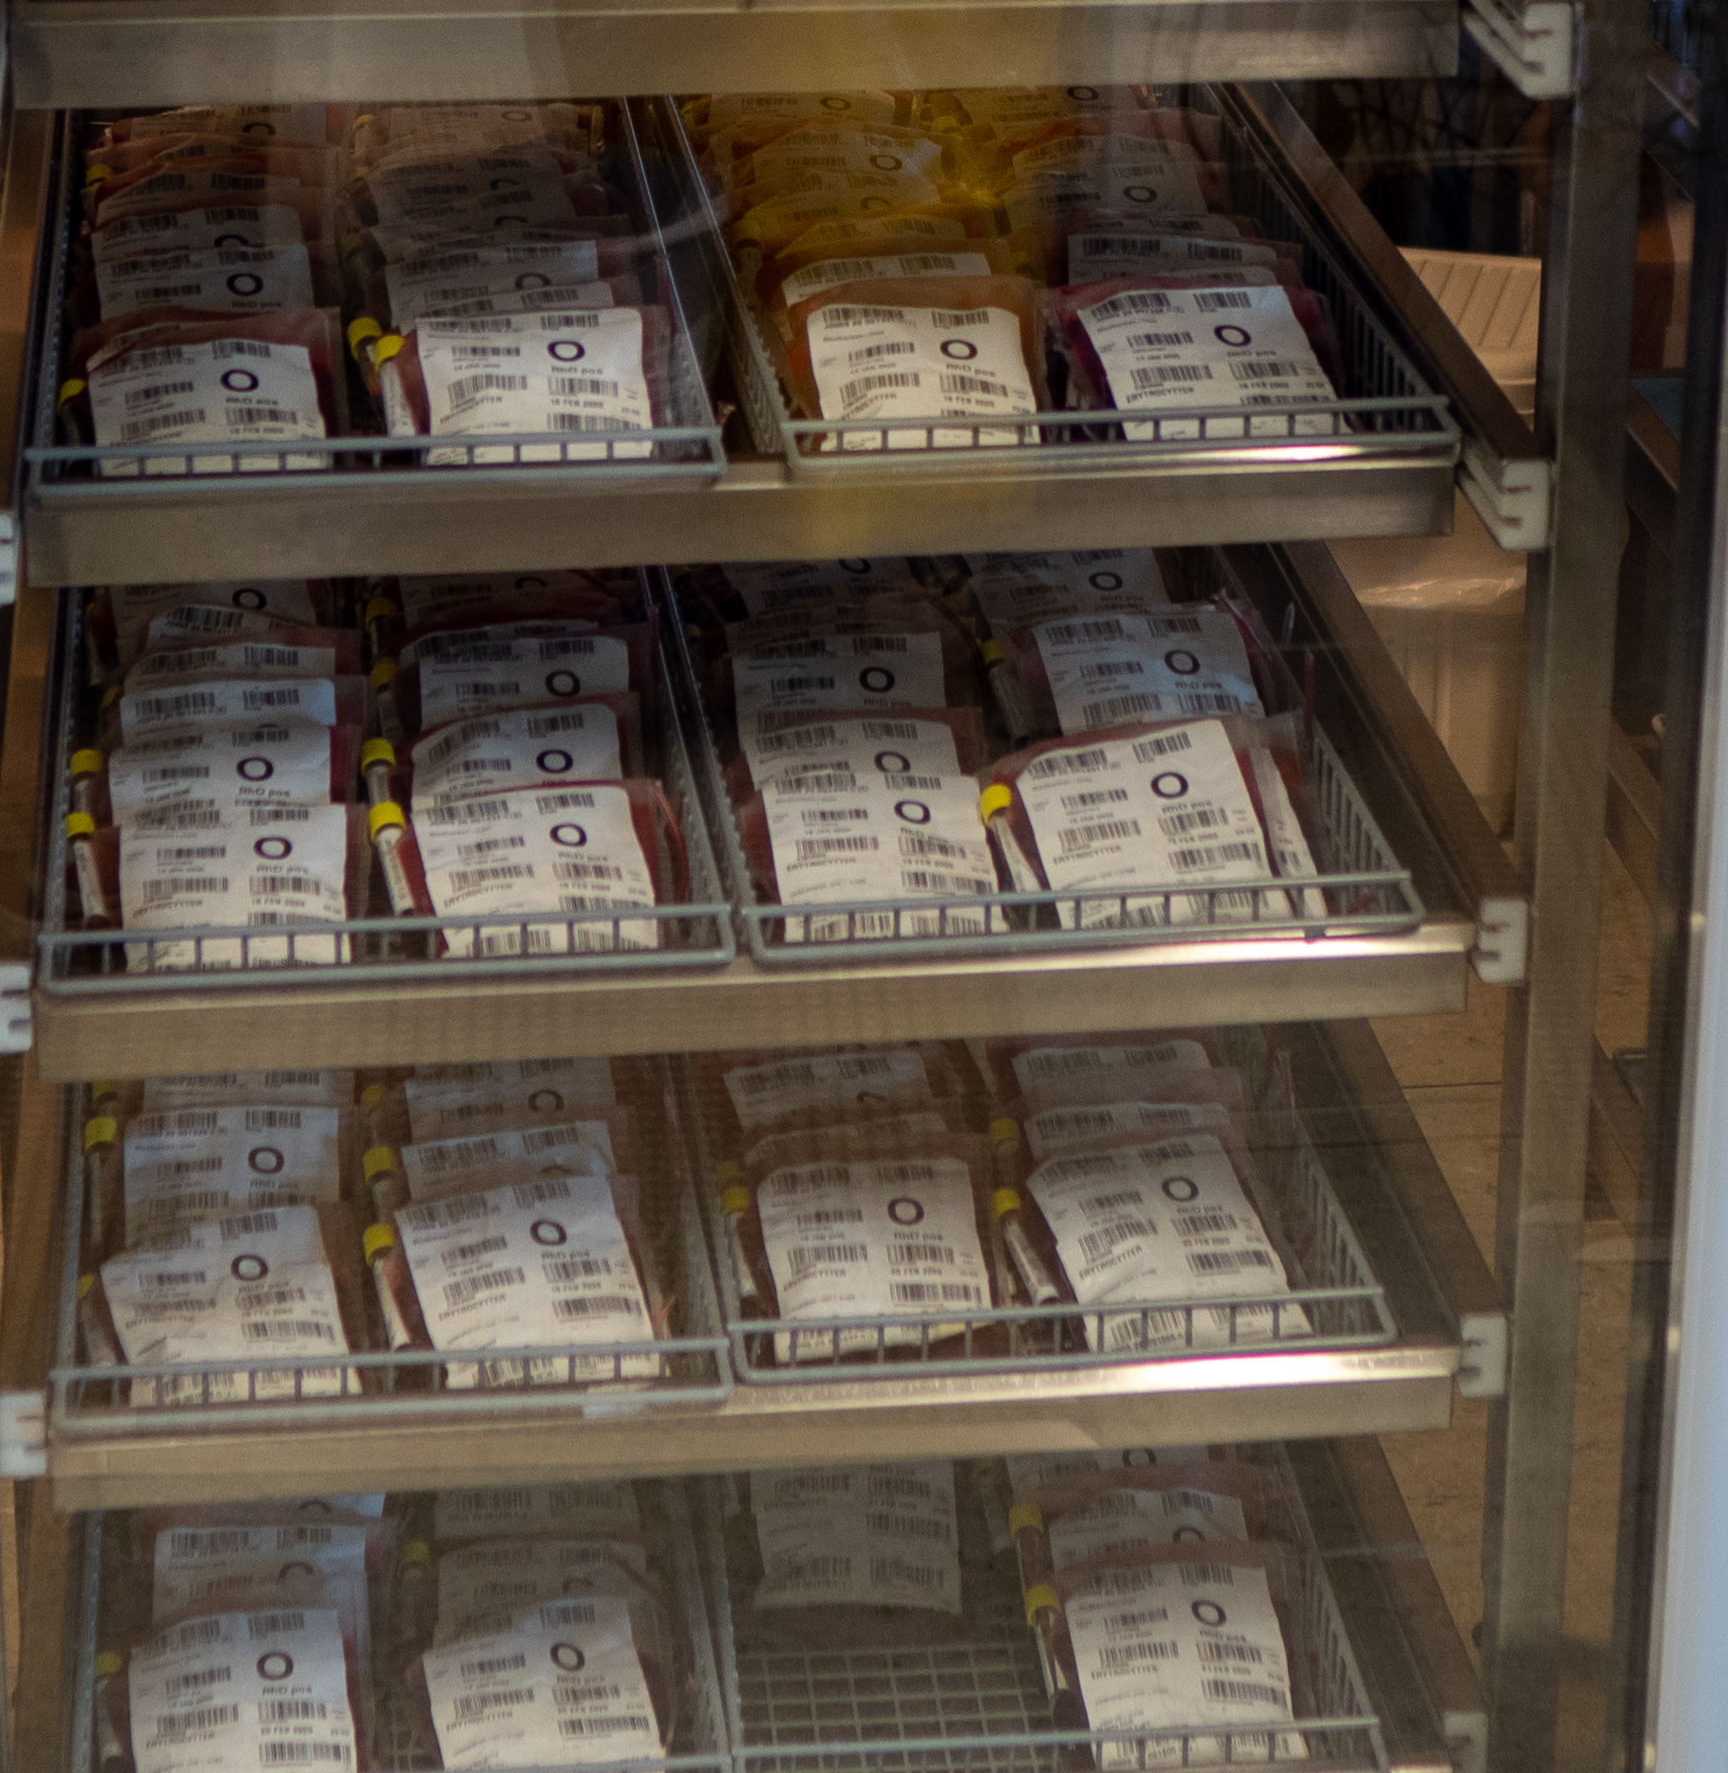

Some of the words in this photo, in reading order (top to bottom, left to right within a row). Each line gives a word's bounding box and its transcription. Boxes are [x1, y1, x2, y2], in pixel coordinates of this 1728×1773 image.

[1122, 186, 1158, 206] O
[225, 272, 264, 297] O
[1213, 324, 1252, 347] O
[547, 340, 586, 362] O
[939, 339, 978, 360] O
[219, 368, 259, 392] O
[1088, 571, 1123, 592] O
[231, 587, 268, 612] O
[1164, 649, 1201, 675] O
[545, 670, 581, 697] O
[858, 666, 896, 693] O
[236, 755, 274, 781] O
[535, 749, 574, 773] O
[874, 750, 911, 772] O
[1150, 771, 1189, 799] O
[893, 800, 931, 825] O
[549, 823, 588, 847] O
[253, 836, 293, 860] O
[247, 1146, 285, 1175] O
[1160, 1175, 1199, 1202] O
[887, 1195, 925, 1225] O
[529, 1218, 568, 1246] O
[230, 1254, 269, 1282] O
[1190, 1599, 1227, 1626] O
[256, 1649, 294, 1680] O
[549, 1641, 586, 1672] O
